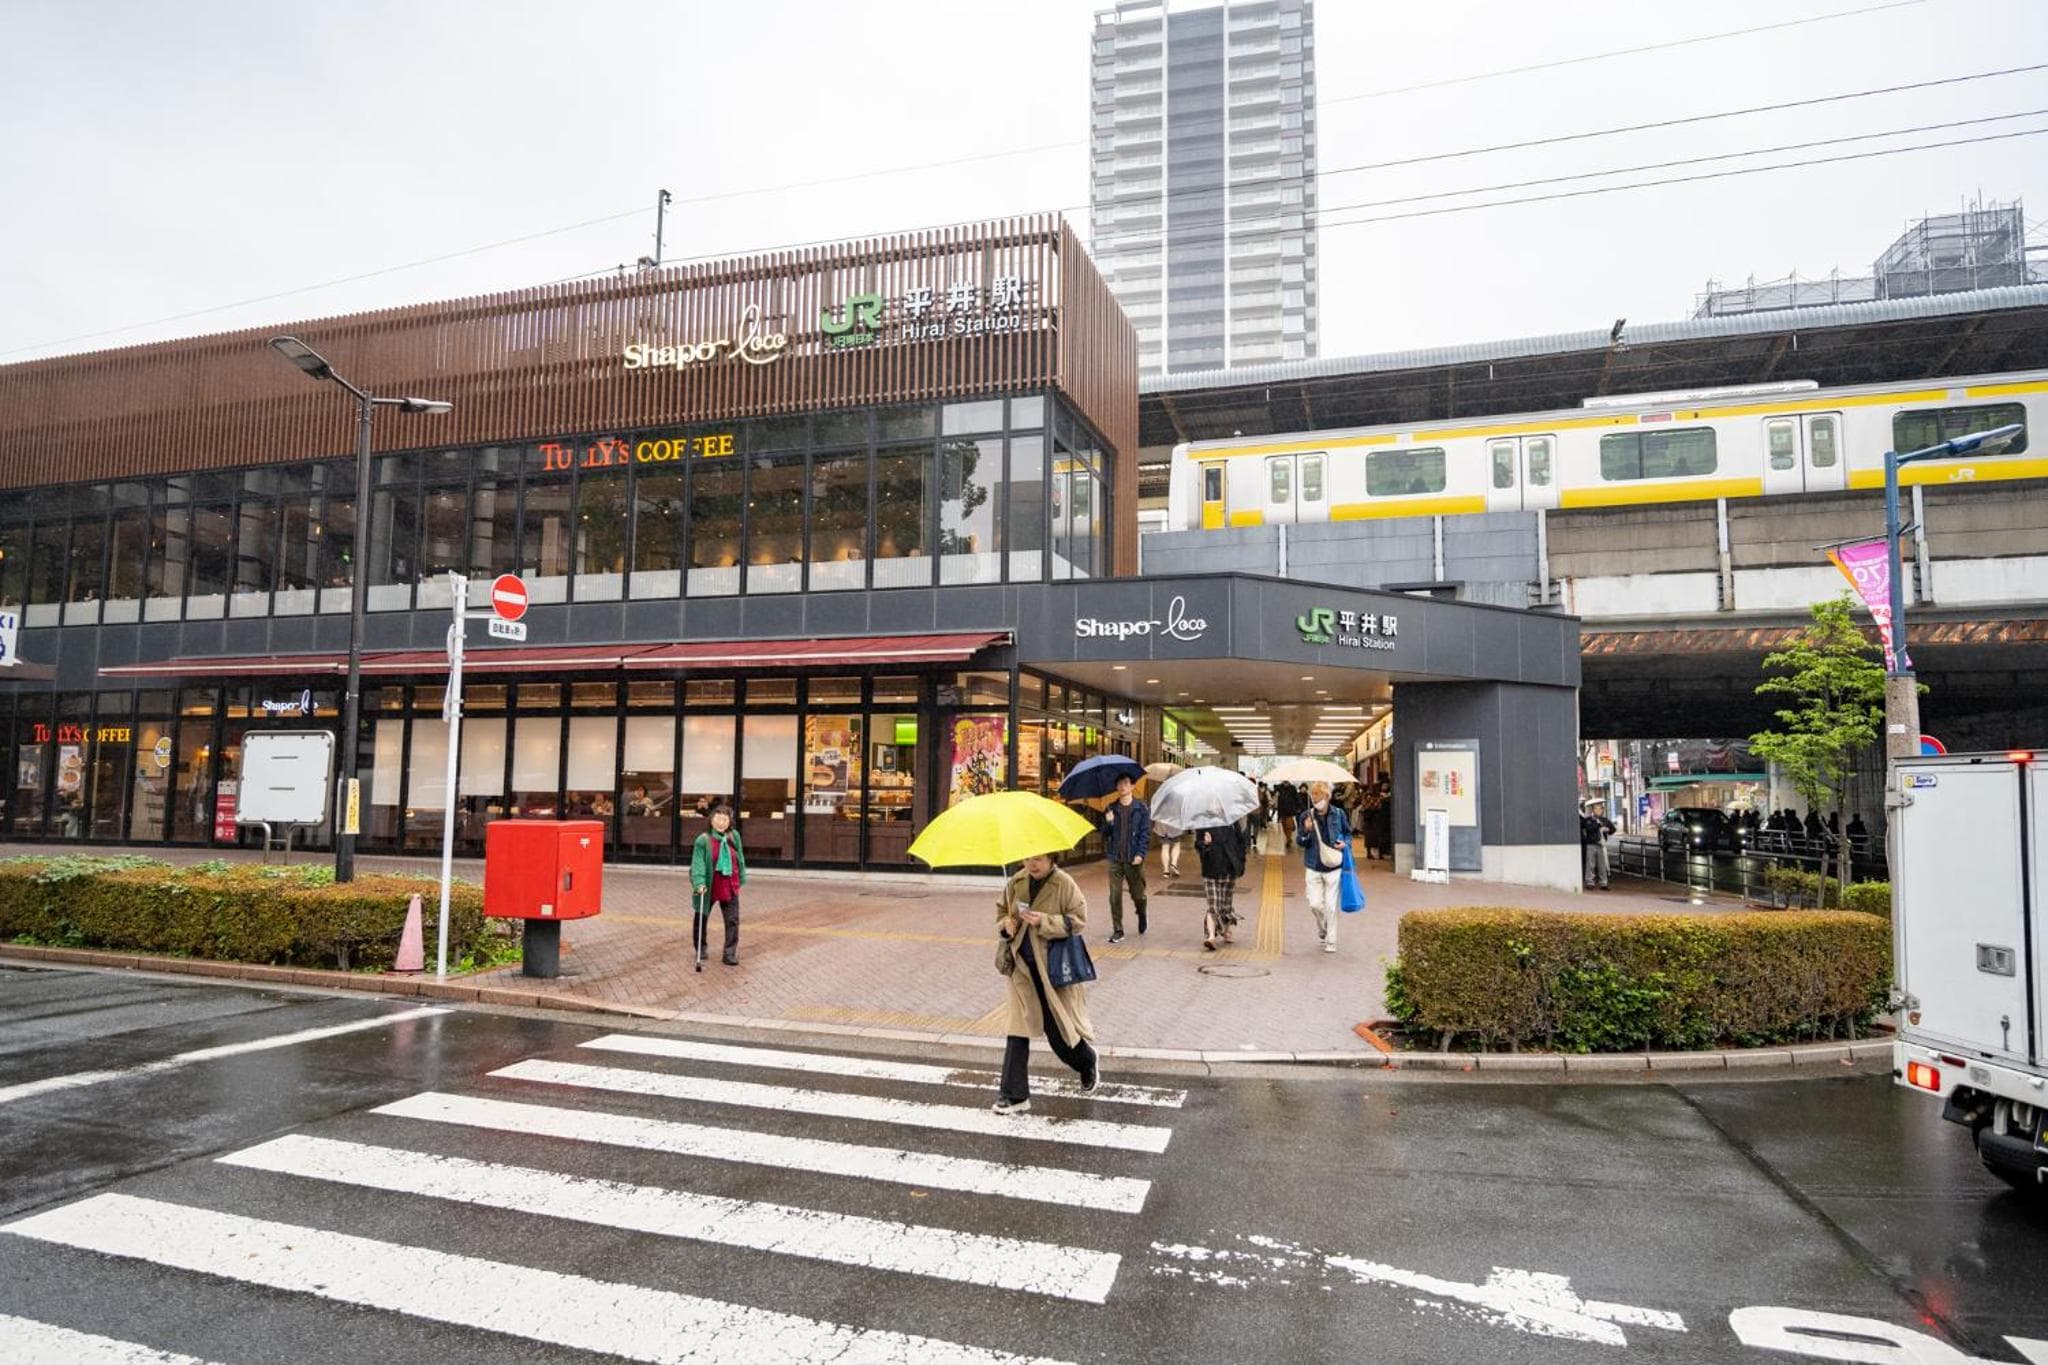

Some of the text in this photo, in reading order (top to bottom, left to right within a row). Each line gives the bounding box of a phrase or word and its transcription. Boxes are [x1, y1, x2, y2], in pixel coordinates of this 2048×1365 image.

[904, 275, 1022, 319] 平井駅
[821, 293, 883, 334] JR
[902, 313, 1021, 341] Hirai Station
[623, 342, 730, 371] Shapo
[1075, 618, 1161, 641] Shapo
[1297, 607, 1335, 634] JR
[1339, 610, 1398, 636] 平井駅
[1338, 634, 1361, 648] Hirai
[1362, 636, 1395, 650] Station
